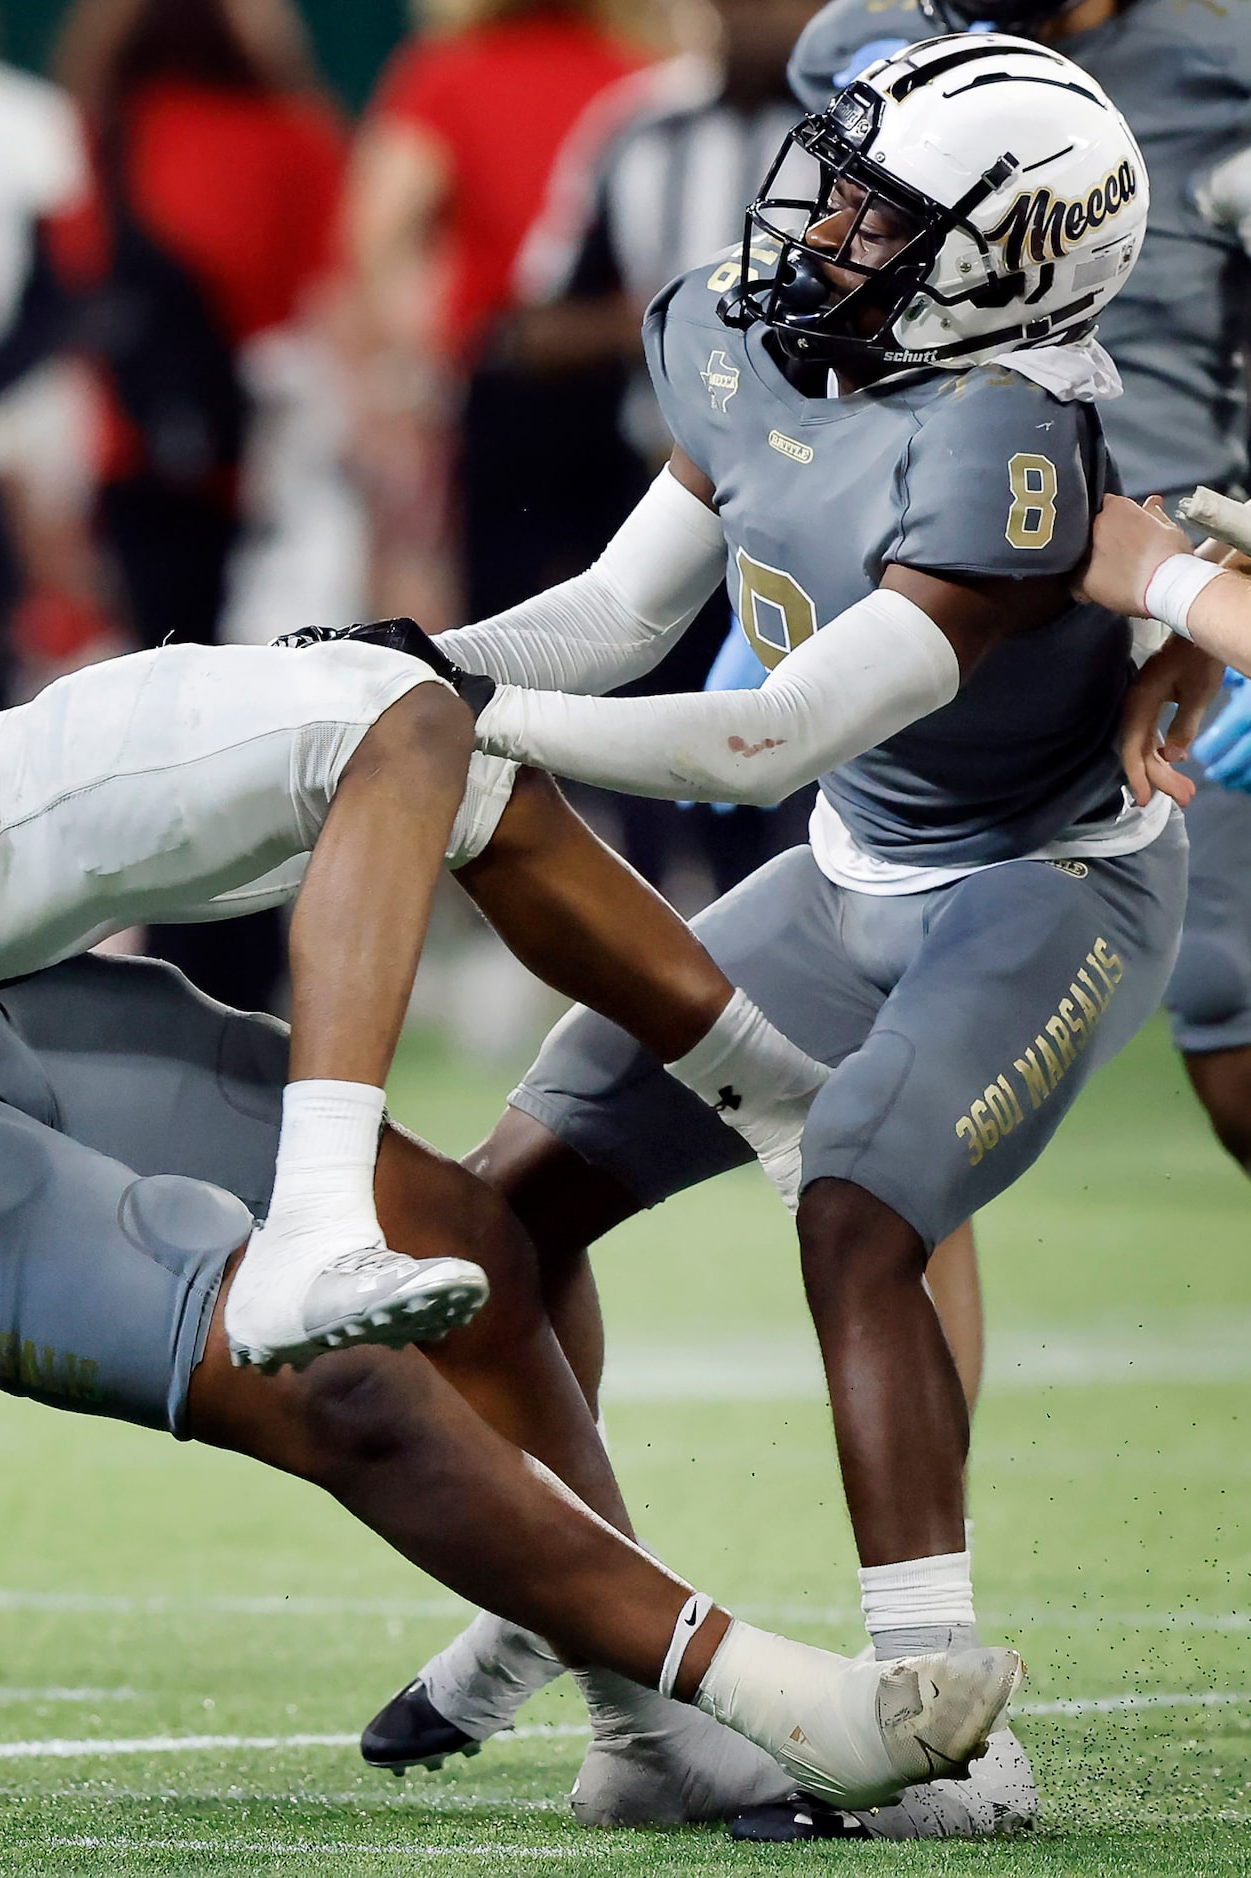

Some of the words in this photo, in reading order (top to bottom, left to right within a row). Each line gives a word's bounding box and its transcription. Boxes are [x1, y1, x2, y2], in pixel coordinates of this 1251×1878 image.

[982, 158, 1137, 274] Mecca
[883, 349, 938, 364] schutt
[770, 432, 811, 460] BATTLE
[1005, 452, 1058, 550] 8
[955, 1073, 1024, 1166] 3601
[1013, 936, 1125, 1109] MARSALIS
